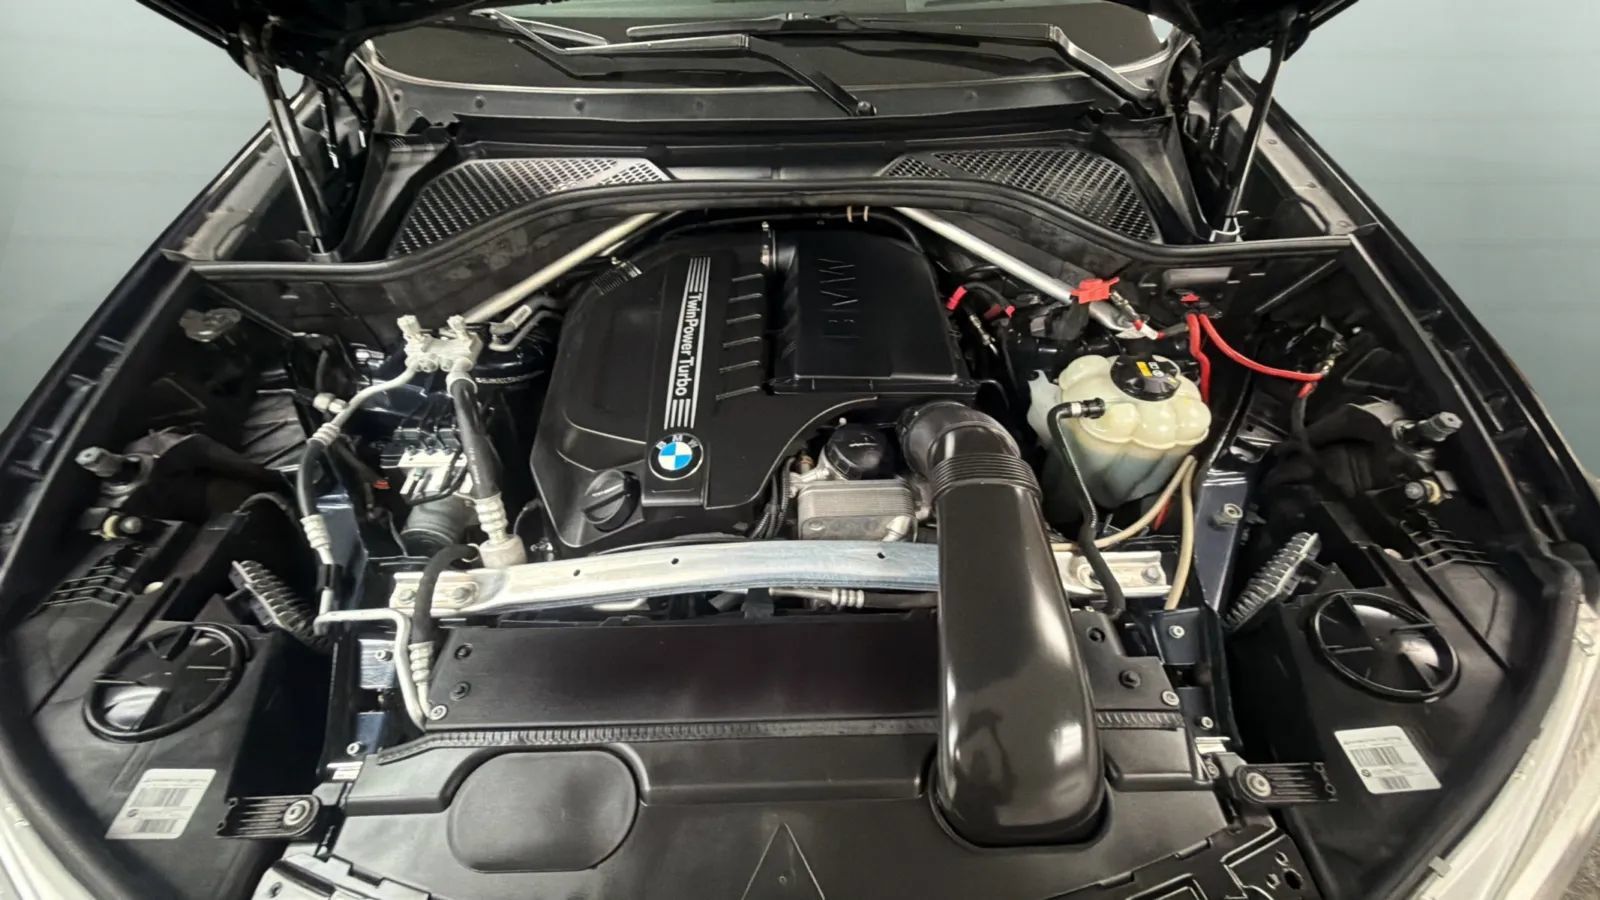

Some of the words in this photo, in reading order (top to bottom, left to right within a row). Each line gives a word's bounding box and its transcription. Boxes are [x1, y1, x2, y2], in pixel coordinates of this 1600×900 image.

[680, 292, 702, 355] TwinPower
[675, 356, 695, 396] Turbo
[655, 434, 699, 450] BMW
